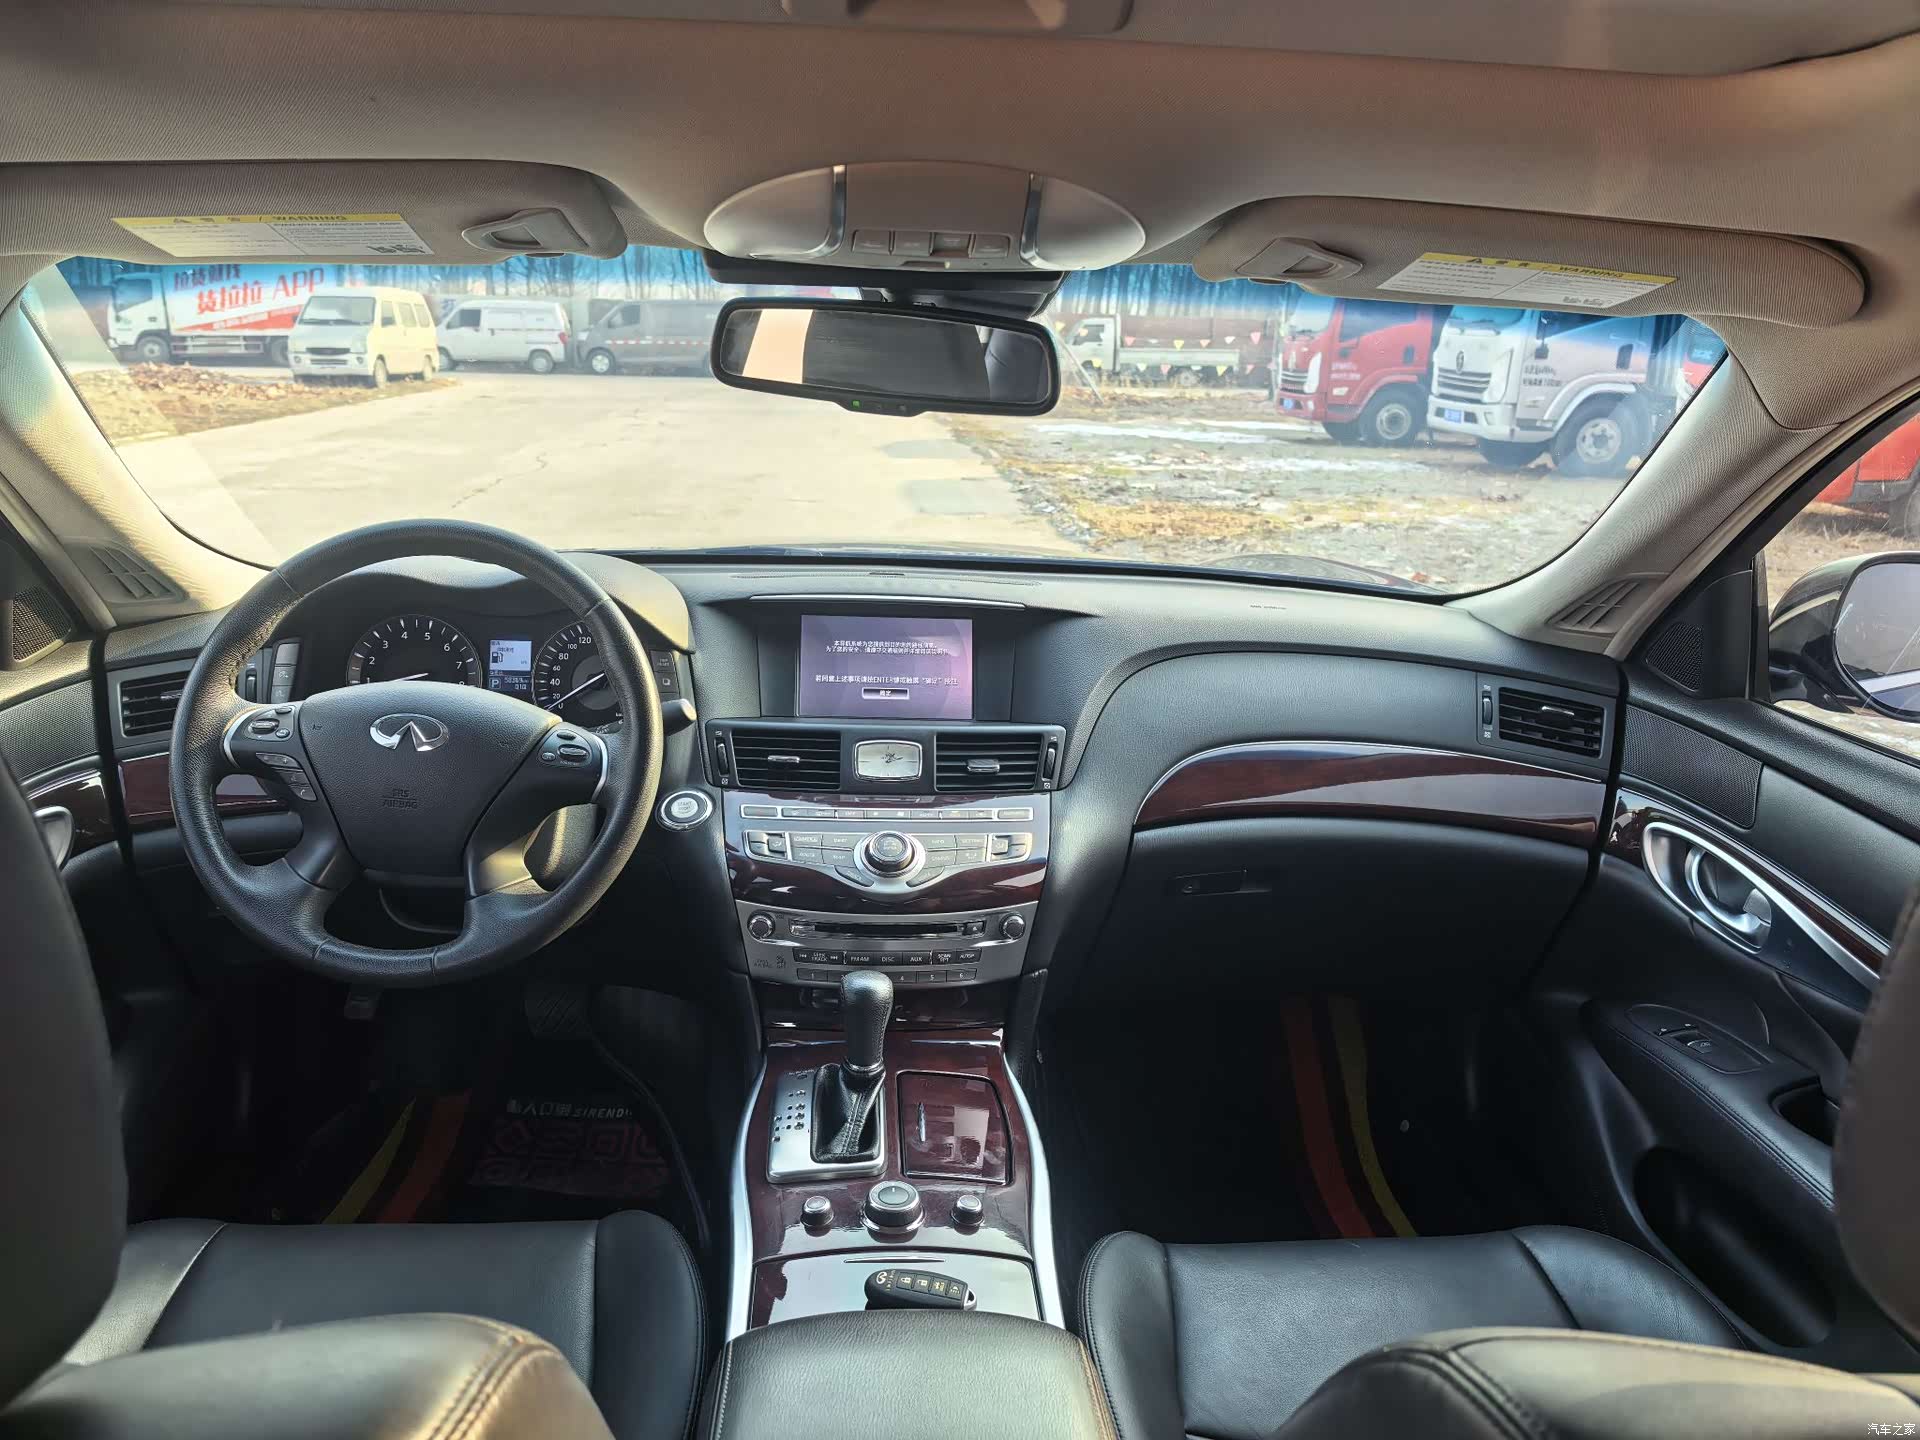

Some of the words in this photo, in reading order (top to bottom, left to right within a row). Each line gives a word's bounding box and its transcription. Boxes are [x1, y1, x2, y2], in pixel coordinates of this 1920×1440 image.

[1559, 265, 1624, 278] WARNING
[401, 631, 408, 640] 4
[424, 632, 431, 641] 5
[578, 636, 592, 644] 120
[382, 640, 389, 649] 3
[443, 643, 450, 652] 6
[369, 656, 375, 665] 2
[558, 652, 569, 660] 80
[455, 661, 462, 670] 7
[552, 664, 561, 672] 60
[491, 679, 499, 688] P
[549, 678, 561, 686] 40
